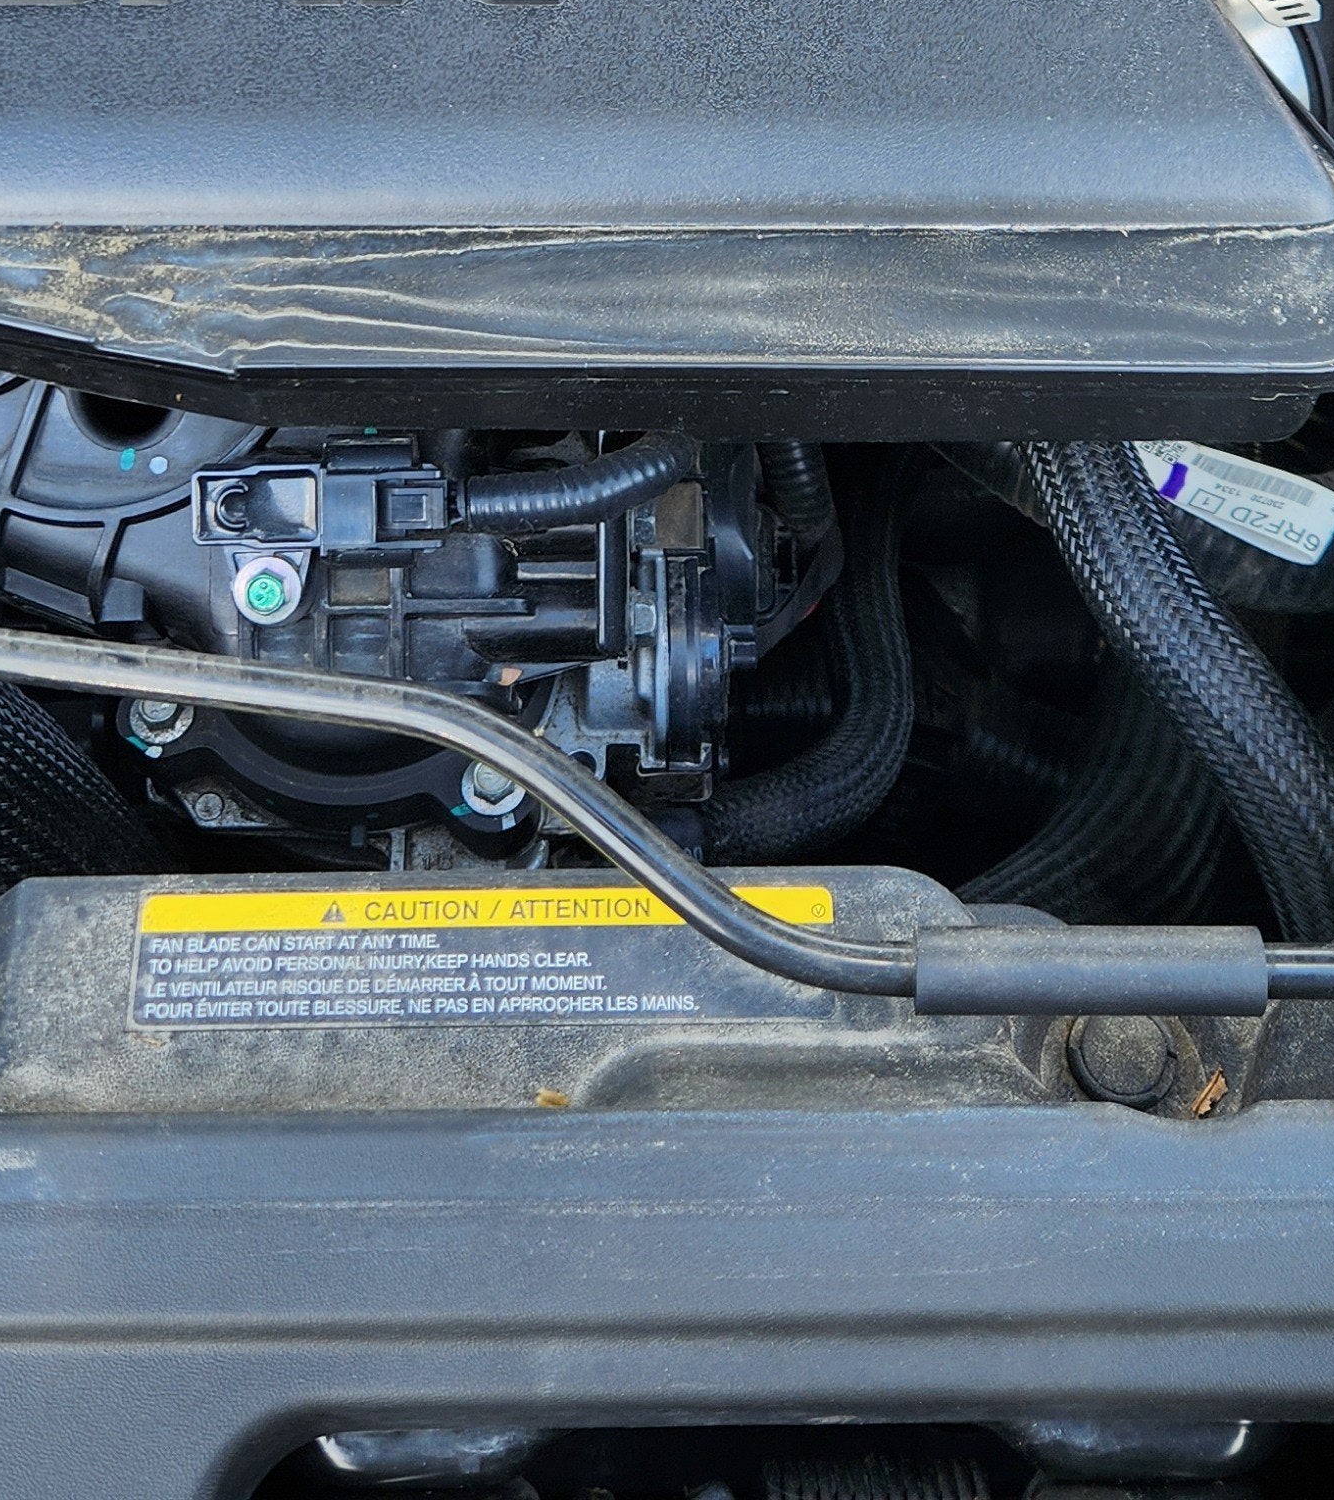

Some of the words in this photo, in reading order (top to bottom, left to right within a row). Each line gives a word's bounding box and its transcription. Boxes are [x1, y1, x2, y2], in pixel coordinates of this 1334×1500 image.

[1230, 505, 1322, 552] 6RF2D
[364, 900, 480, 921] CAUTION
[509, 897, 651, 919] ATTENTION
[148, 936, 184, 954] FAN
[186, 936, 242, 953] BLADE
[245, 936, 281, 951] CAN
[284, 935, 335, 951] START
[337, 934, 359, 950] AT
[361, 934, 396, 949] ANY
[398, 933, 440, 949] TIME.
[147, 957, 173, 975] TO
[174, 957, 219, 974] HELP
[221, 956, 273, 973] AVOID
[275, 954, 365, 972] PERSONAL
[470, 952, 530, 970] HANDS
[534, 951, 592, 968] CLEAR.
[145, 981, 167, 999] LE
[168, 979, 278, 998] VENTILATEUR
[280, 978, 344, 996] RISQUE
[347, 977, 371, 994] DE
[373, 973, 466, 994] DÉMARRER
[467, 972, 481, 992] À
[484, 975, 529, 992] TOUT
[530, 974, 607, 992] MOMENT.
[144, 1002, 193, 1019] POUR
[195, 997, 253, 1018] ÉVITER
[255, 999, 310, 1017] TOUTE
[312, 998, 405, 1017] BLESSURE,
[407, 998, 433, 1015] NE
[434, 997, 468, 1014] PAS
[471, 997, 496, 1014] EN
[498, 996, 604, 1014] APPROCHER
[606, 994, 638, 1012] LES
[640, 994, 701, 1012] MAINS.
